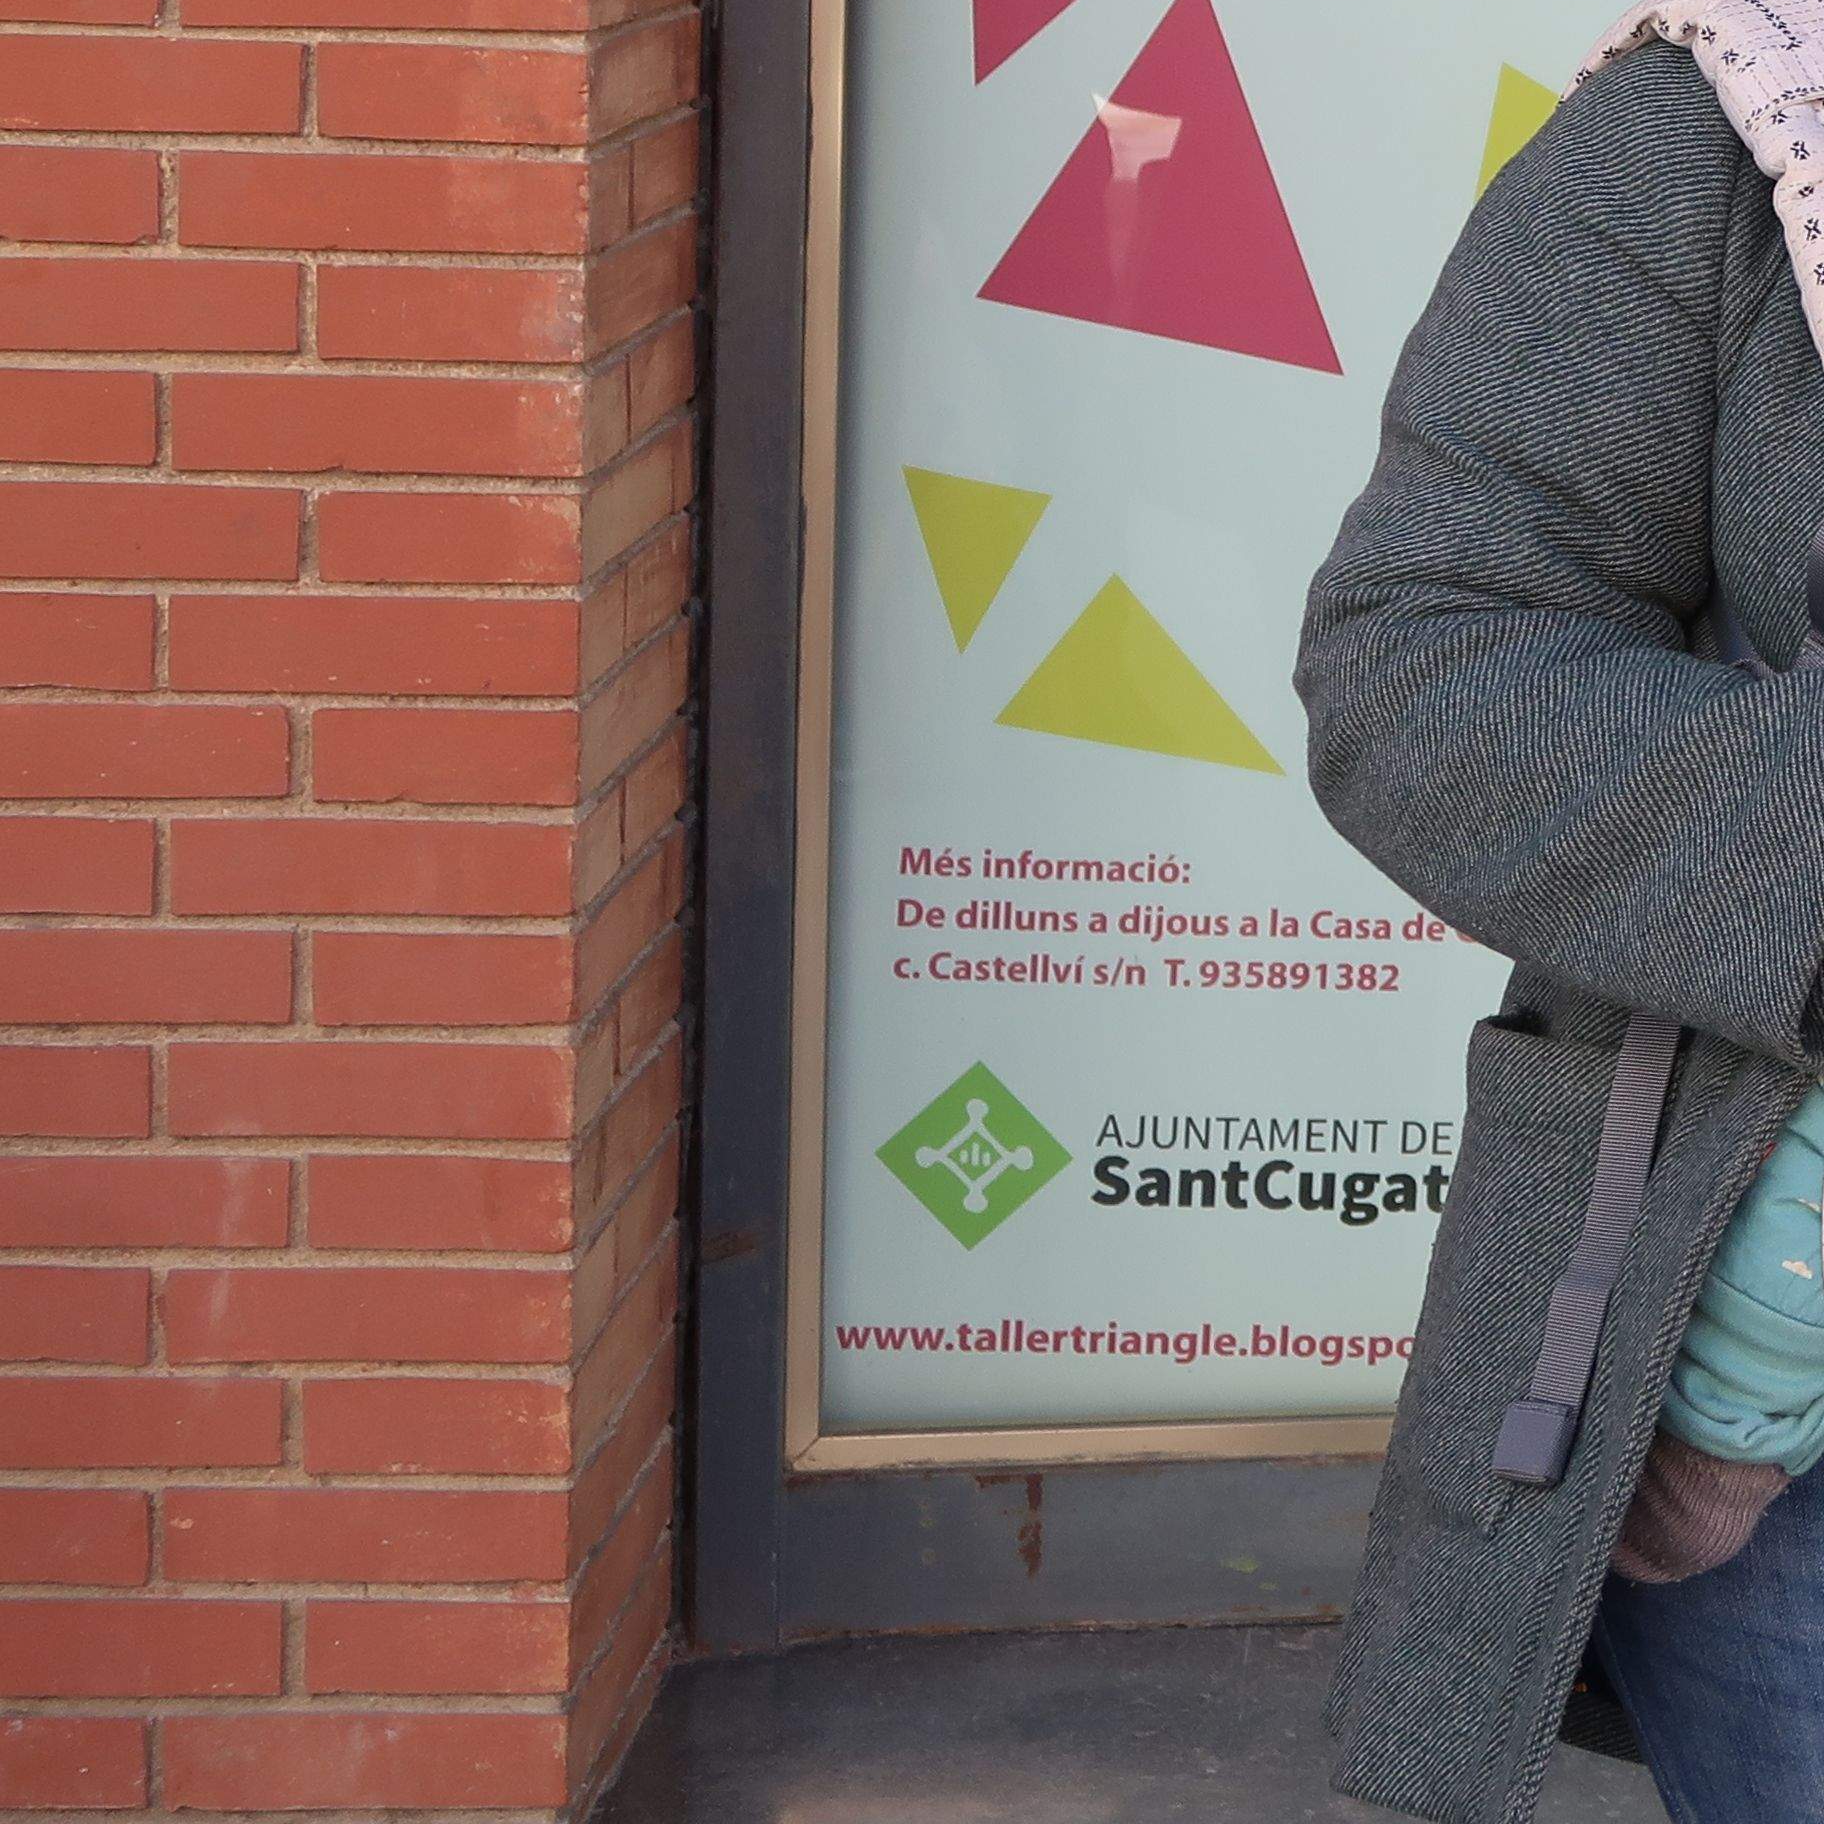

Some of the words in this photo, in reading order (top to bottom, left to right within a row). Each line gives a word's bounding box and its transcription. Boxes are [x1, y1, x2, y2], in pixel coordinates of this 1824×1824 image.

[899, 846, 972, 878] Més
[981, 849, 1192, 885] informació:
[896, 898, 946, 929] De
[955, 900, 1079, 934] dilluns
[1087, 913, 1109, 935] a
[1117, 903, 1230, 944] dijous
[1239, 916, 1259, 937] a
[1269, 907, 1301, 939] la
[1310, 911, 1391, 941] Casa
[1401, 910, 1446, 943] de
[892, 956, 921, 980] c.
[927, 953, 1084, 985] Castellví
[1092, 955, 1147, 987] s/n
[1163, 959, 1192, 988] T.
[1198, 959, 1401, 994] 935891382
[1096, 1114, 1389, 1155] AJUNTAMENT
[1400, 1120, 1454, 1156] DE
[1091, 1155, 1451, 1227] SantCugat
[836, 1320, 1416, 1366] www.tallertriangle.blogspo
